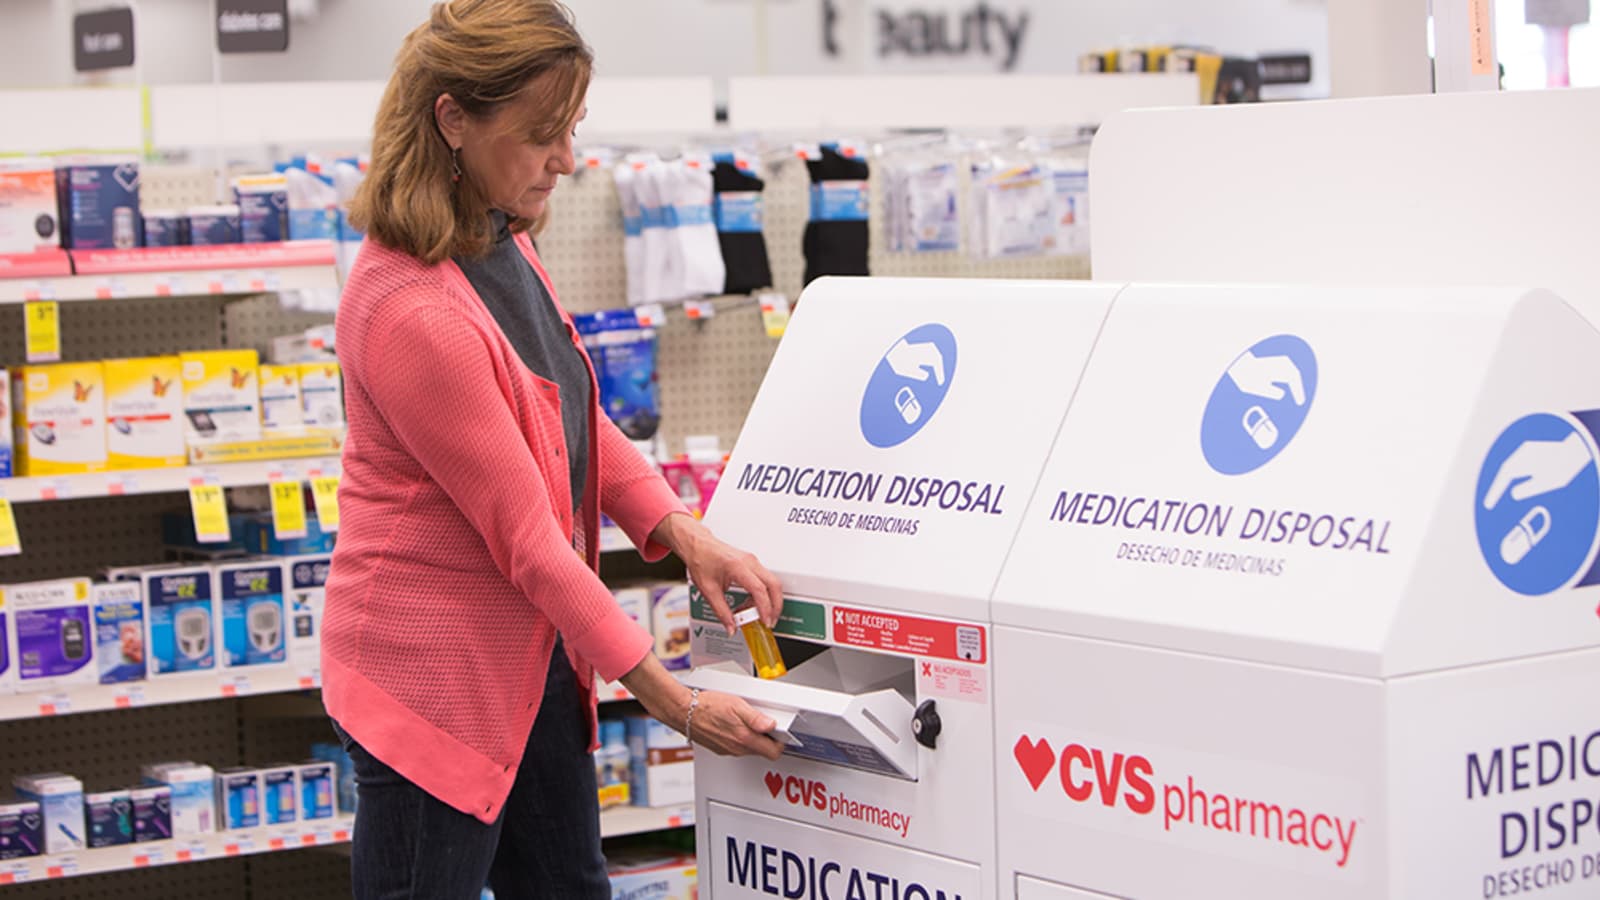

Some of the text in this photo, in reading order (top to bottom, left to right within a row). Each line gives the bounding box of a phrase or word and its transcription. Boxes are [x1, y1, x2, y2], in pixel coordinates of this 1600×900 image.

[737, 463, 1005, 515] MEDICATION DISPOSAL
[788, 507, 920, 535] DESECHO DE MEDICINAS
[1049, 491, 1391, 554] MEDICATION DISPOSAL
[1116, 542, 1286, 576] DESECHO DE MEDICINAS
[845, 612, 900, 631] NOT ACCEPTED
[785, 775, 911, 838] CVS pharmacy
[1060, 744, 1357, 867] CVS pharmacy
[1500, 797, 1600, 859] DISP
[726, 836, 963, 900] MEDICAT
[1483, 857, 1575, 899] DESECHO
